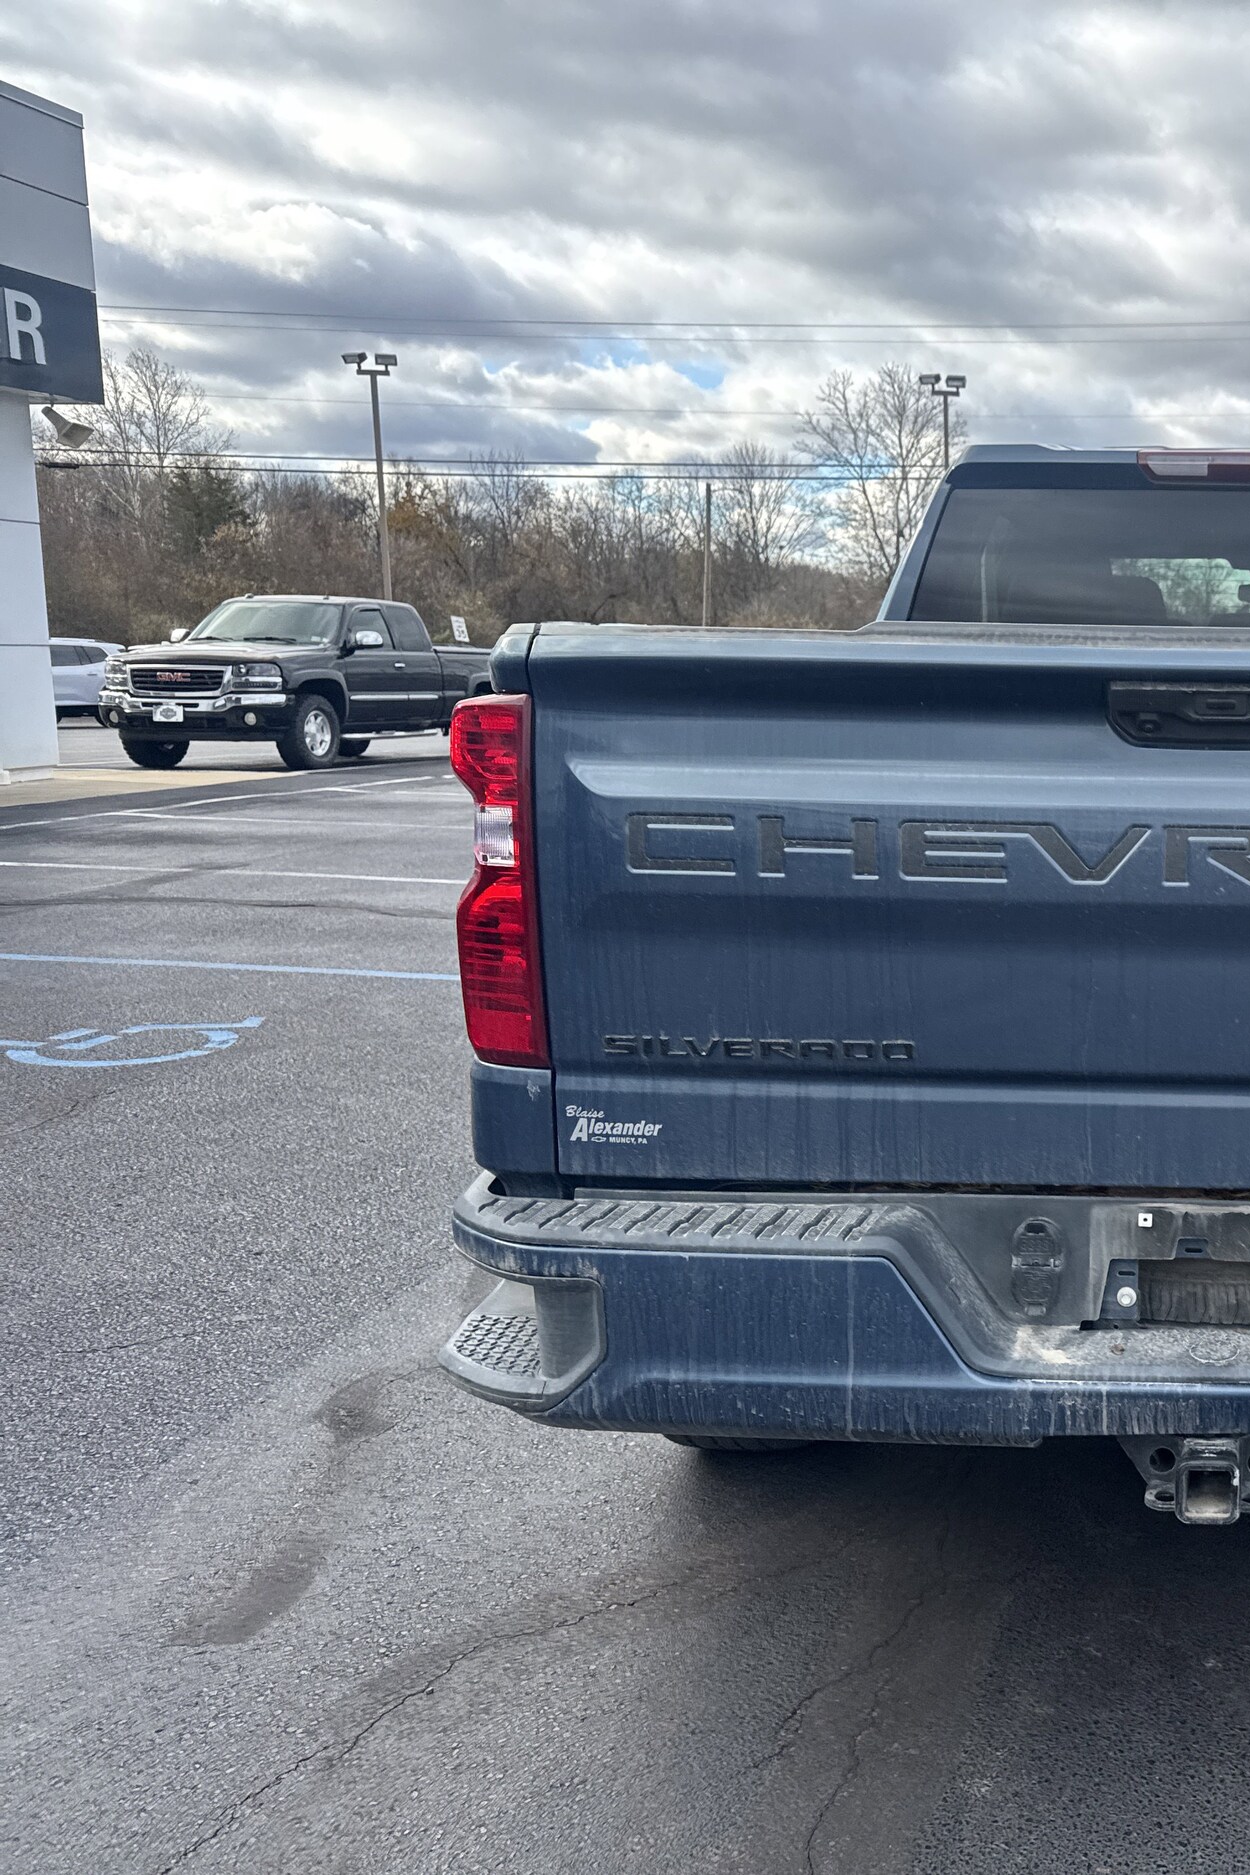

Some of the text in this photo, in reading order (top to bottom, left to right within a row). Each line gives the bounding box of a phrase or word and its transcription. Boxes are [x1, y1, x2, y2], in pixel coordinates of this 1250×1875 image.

[156, 671, 191, 682] GMC
[602, 1035, 915, 1061] SILVERADO
[565, 1105, 605, 1119] Blaise
[569, 1117, 662, 1142] Alexander
[609, 1136, 648, 1145] MUNCY, PA
